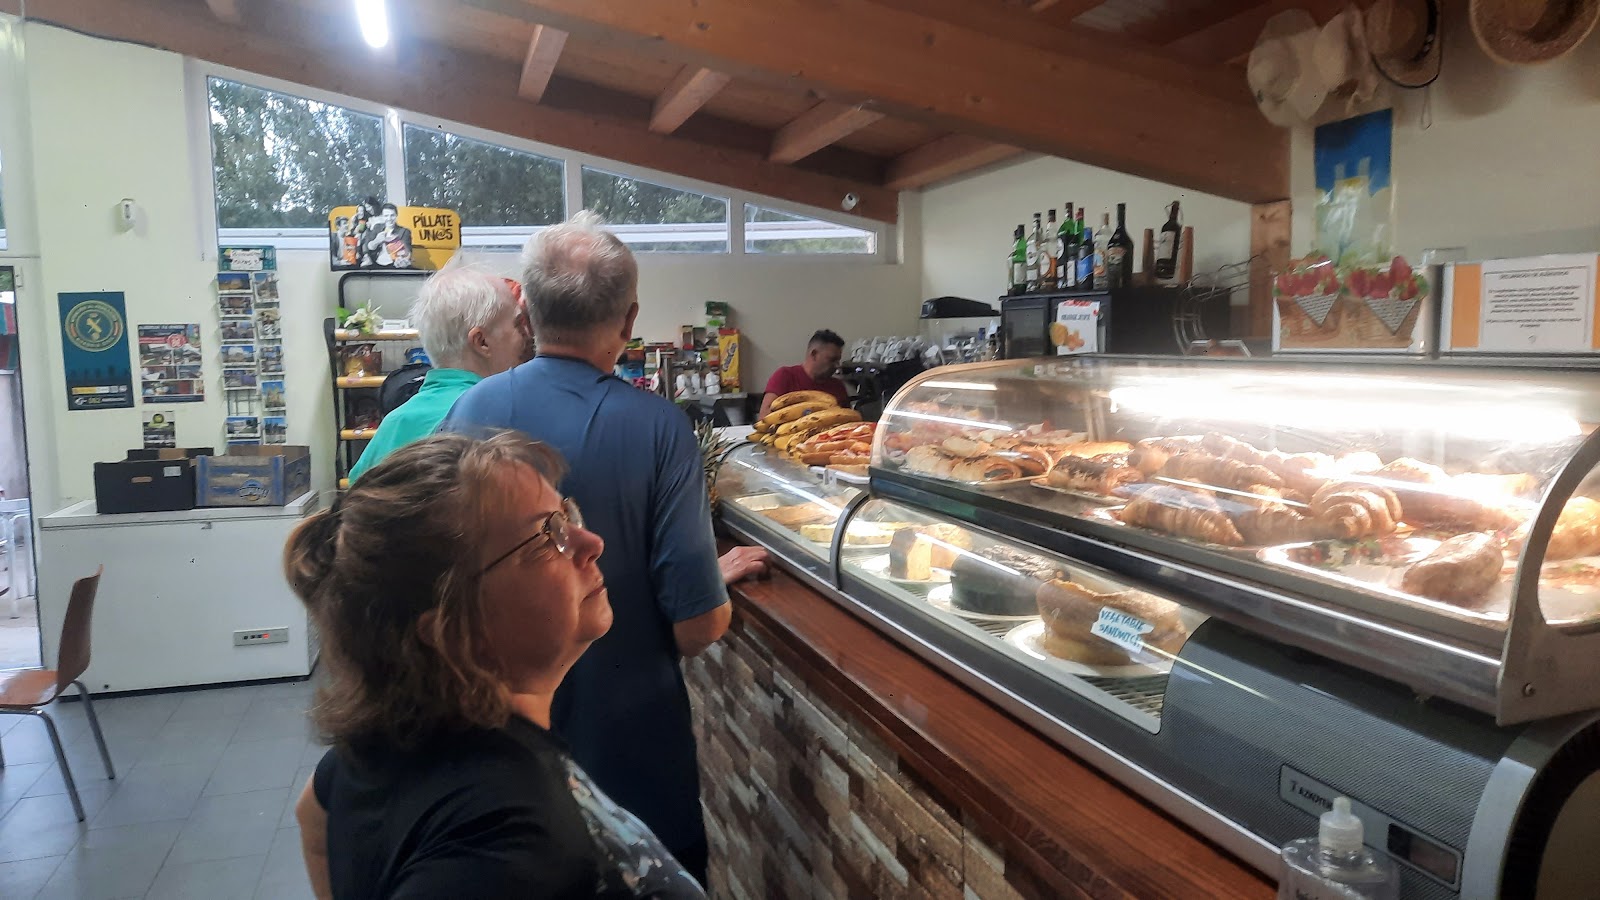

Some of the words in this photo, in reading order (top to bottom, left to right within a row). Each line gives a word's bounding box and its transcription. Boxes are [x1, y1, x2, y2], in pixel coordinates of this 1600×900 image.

[413, 213, 452, 228] PÍLLATE
[419, 229, 452, 241] UN@S
[1101, 610, 1145, 631] VEGETABLE
